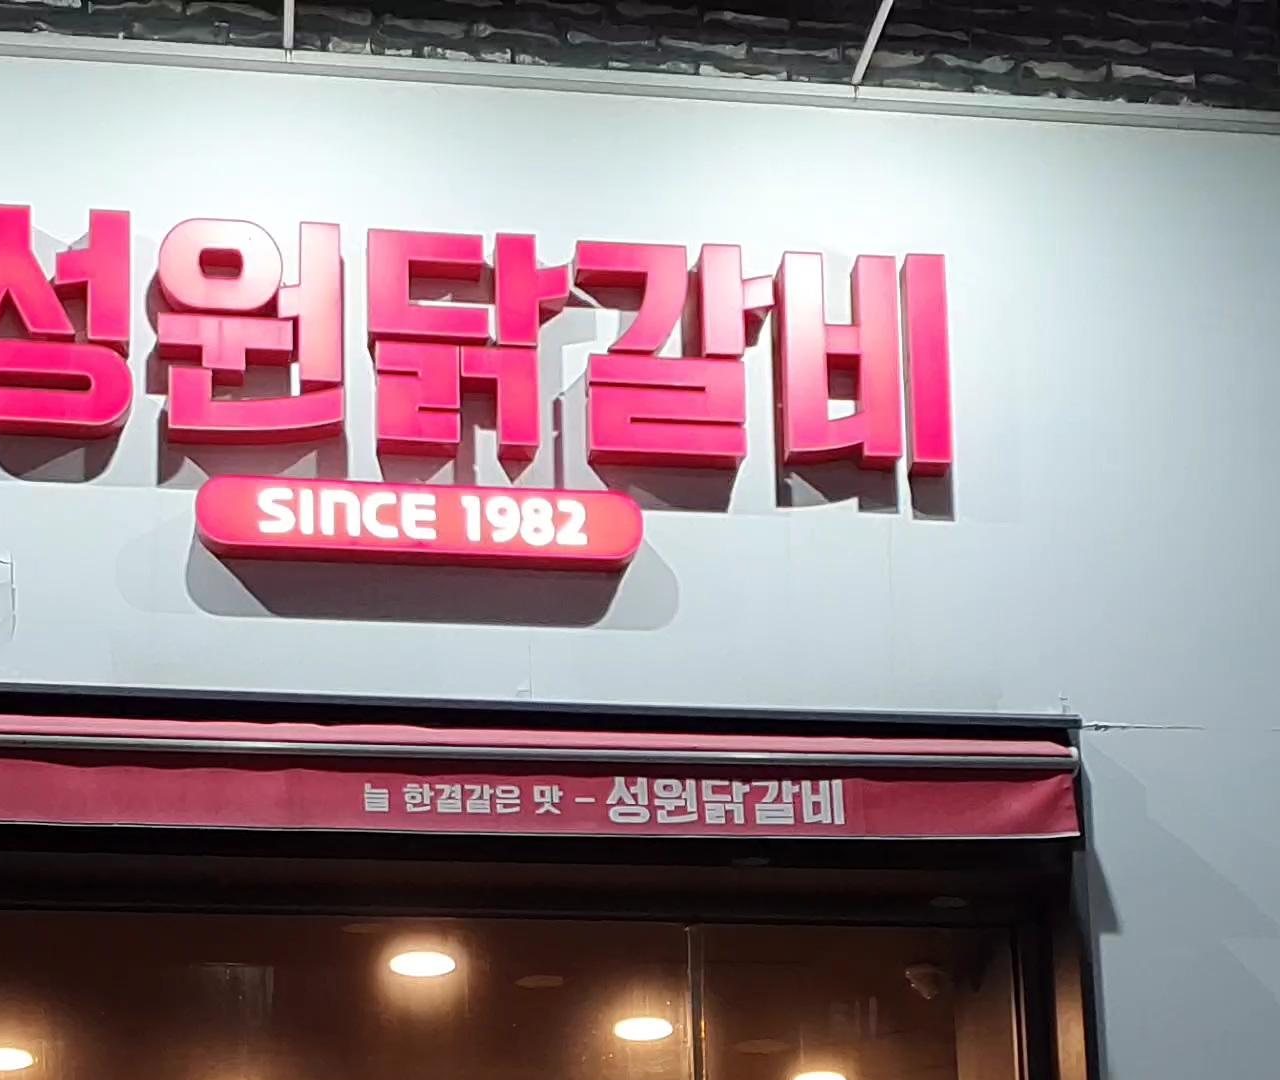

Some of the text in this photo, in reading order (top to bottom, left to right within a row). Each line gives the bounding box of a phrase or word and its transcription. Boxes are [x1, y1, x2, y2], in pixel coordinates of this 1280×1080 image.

[257, 487, 589, 547] SINCE 1982
[363, 784, 389, 813] 늘
[403, 782, 521, 814] 한결같은
[533, 785, 563, 815] 맛
[606, 777, 845, 826] 성원닭갈비
